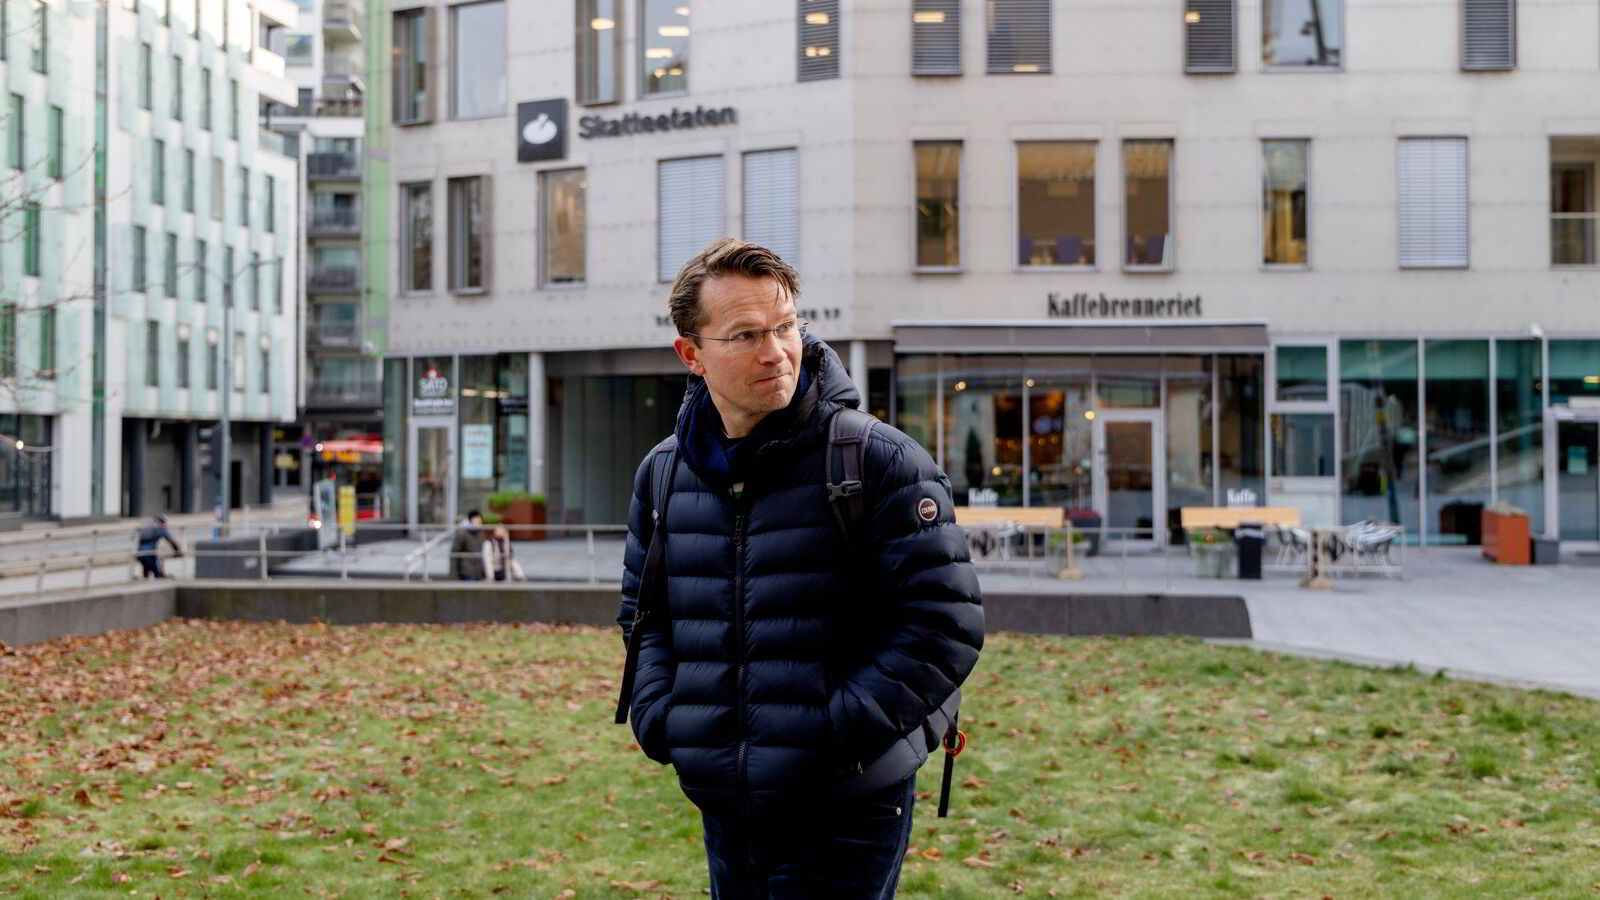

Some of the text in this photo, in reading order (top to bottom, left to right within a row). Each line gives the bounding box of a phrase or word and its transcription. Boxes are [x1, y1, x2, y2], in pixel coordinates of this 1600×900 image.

[579, 105, 737, 140] Skatteetaten
[1048, 293, 1203, 317] Kaffebrenneriet
[968, 487, 999, 503] Kaffe
[1227, 488, 1258, 503] Kaffe
